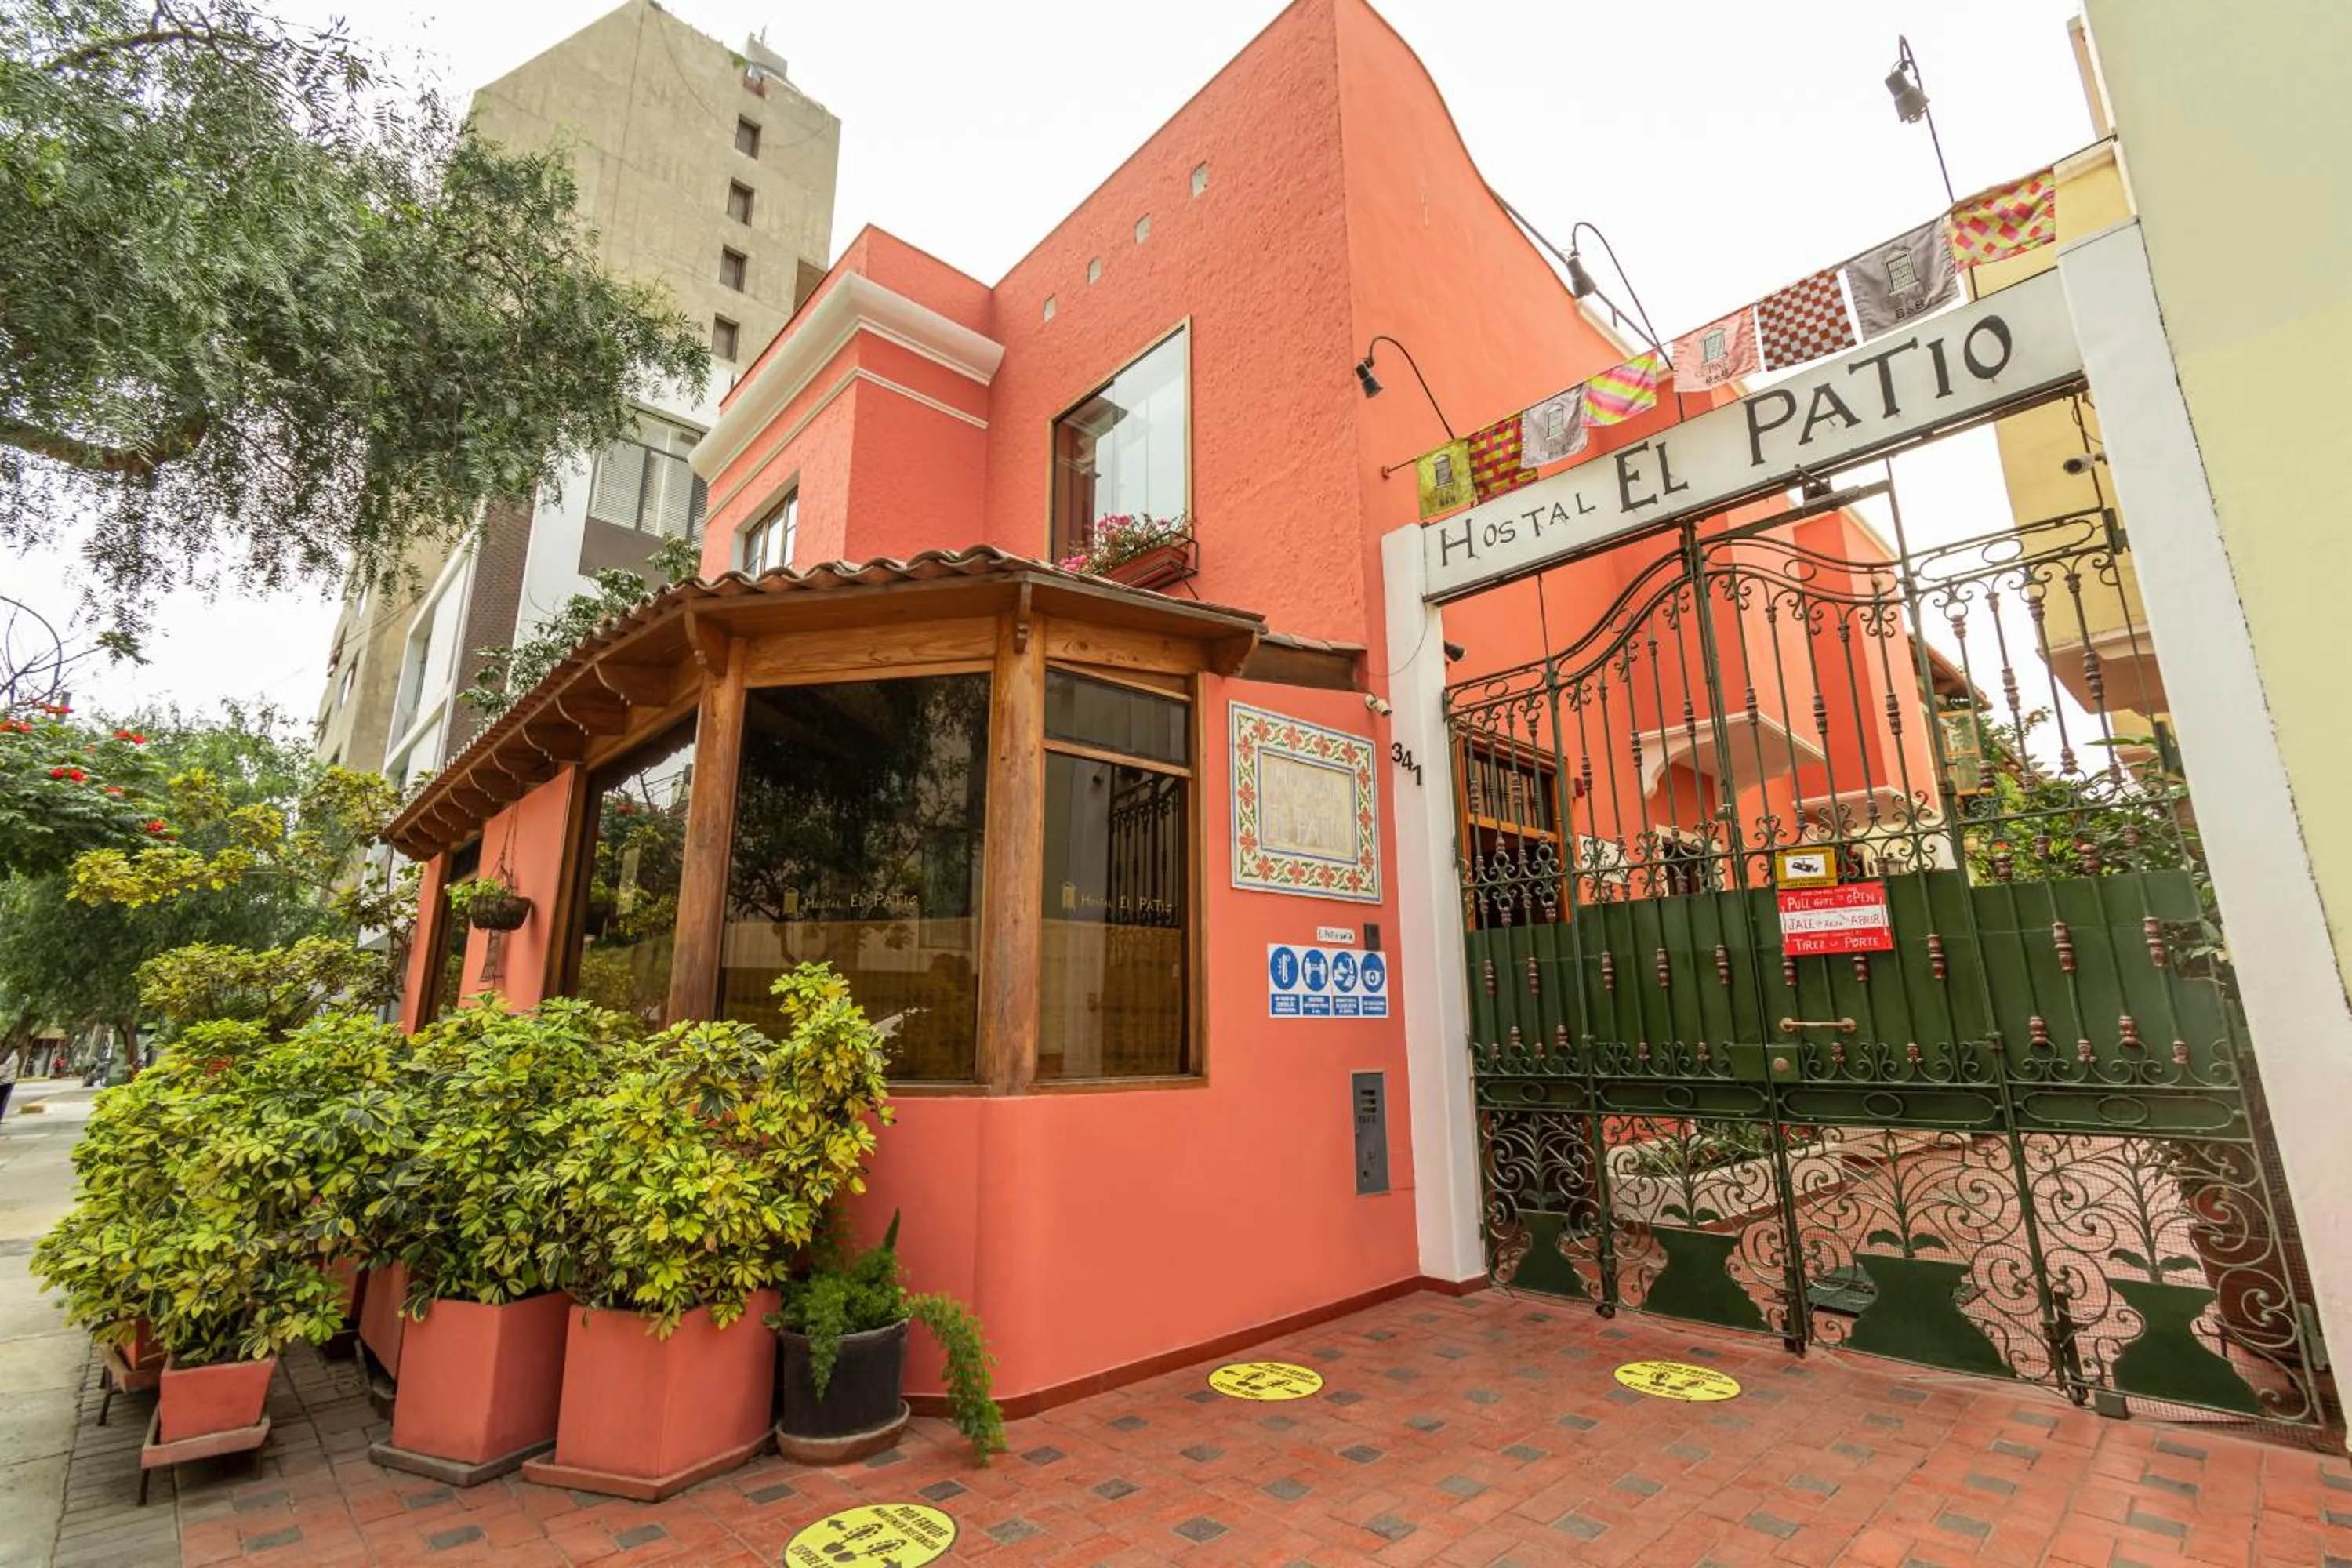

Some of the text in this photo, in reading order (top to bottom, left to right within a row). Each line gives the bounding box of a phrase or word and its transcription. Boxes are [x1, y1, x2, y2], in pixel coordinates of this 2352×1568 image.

[1440, 314, 2013, 568] HOSTAL EL PATIO
[1392, 742, 1421, 786] 341
[874, 892, 919, 907] PATIO
[1139, 896, 1173, 913] PATIO
[1788, 896, 1810, 911] PULL
[1846, 890, 1875, 904] OPEN
[1787, 918, 1816, 931] JALE
[1850, 914, 1881, 926] ABRIR
[1844, 936, 1879, 949] PORTE
